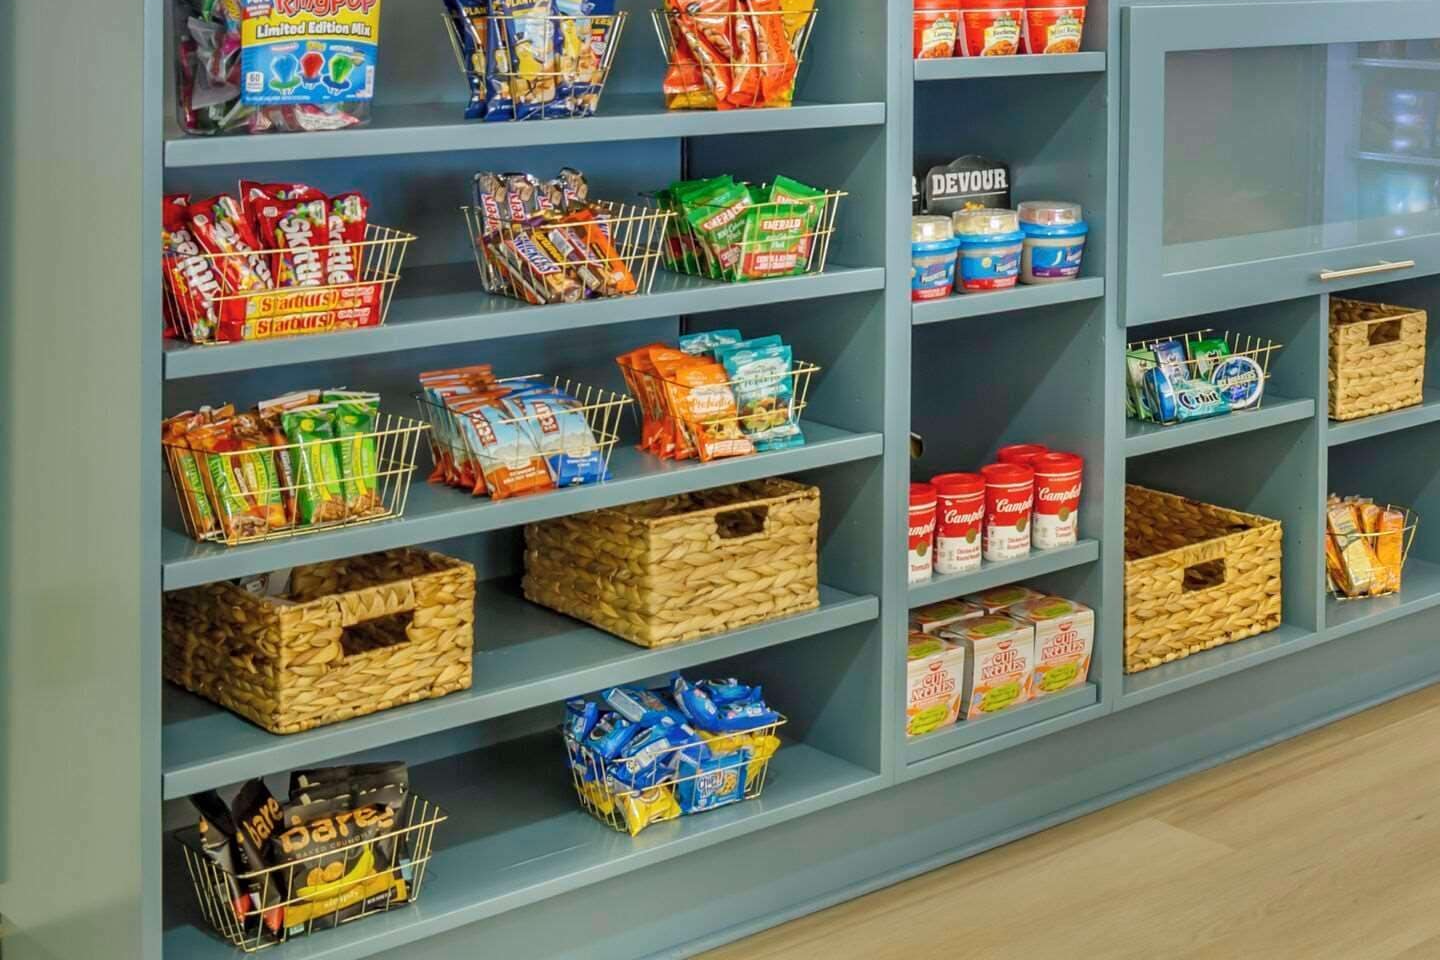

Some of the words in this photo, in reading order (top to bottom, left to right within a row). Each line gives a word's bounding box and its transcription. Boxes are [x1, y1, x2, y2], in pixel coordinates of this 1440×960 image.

[256, 22, 306, 39] Limited
[307, 21, 350, 36] Edition
[351, 23, 371, 38] Mix
[932, 168, 1009, 196] DEVOUR
[243, 797, 283, 848] bare
